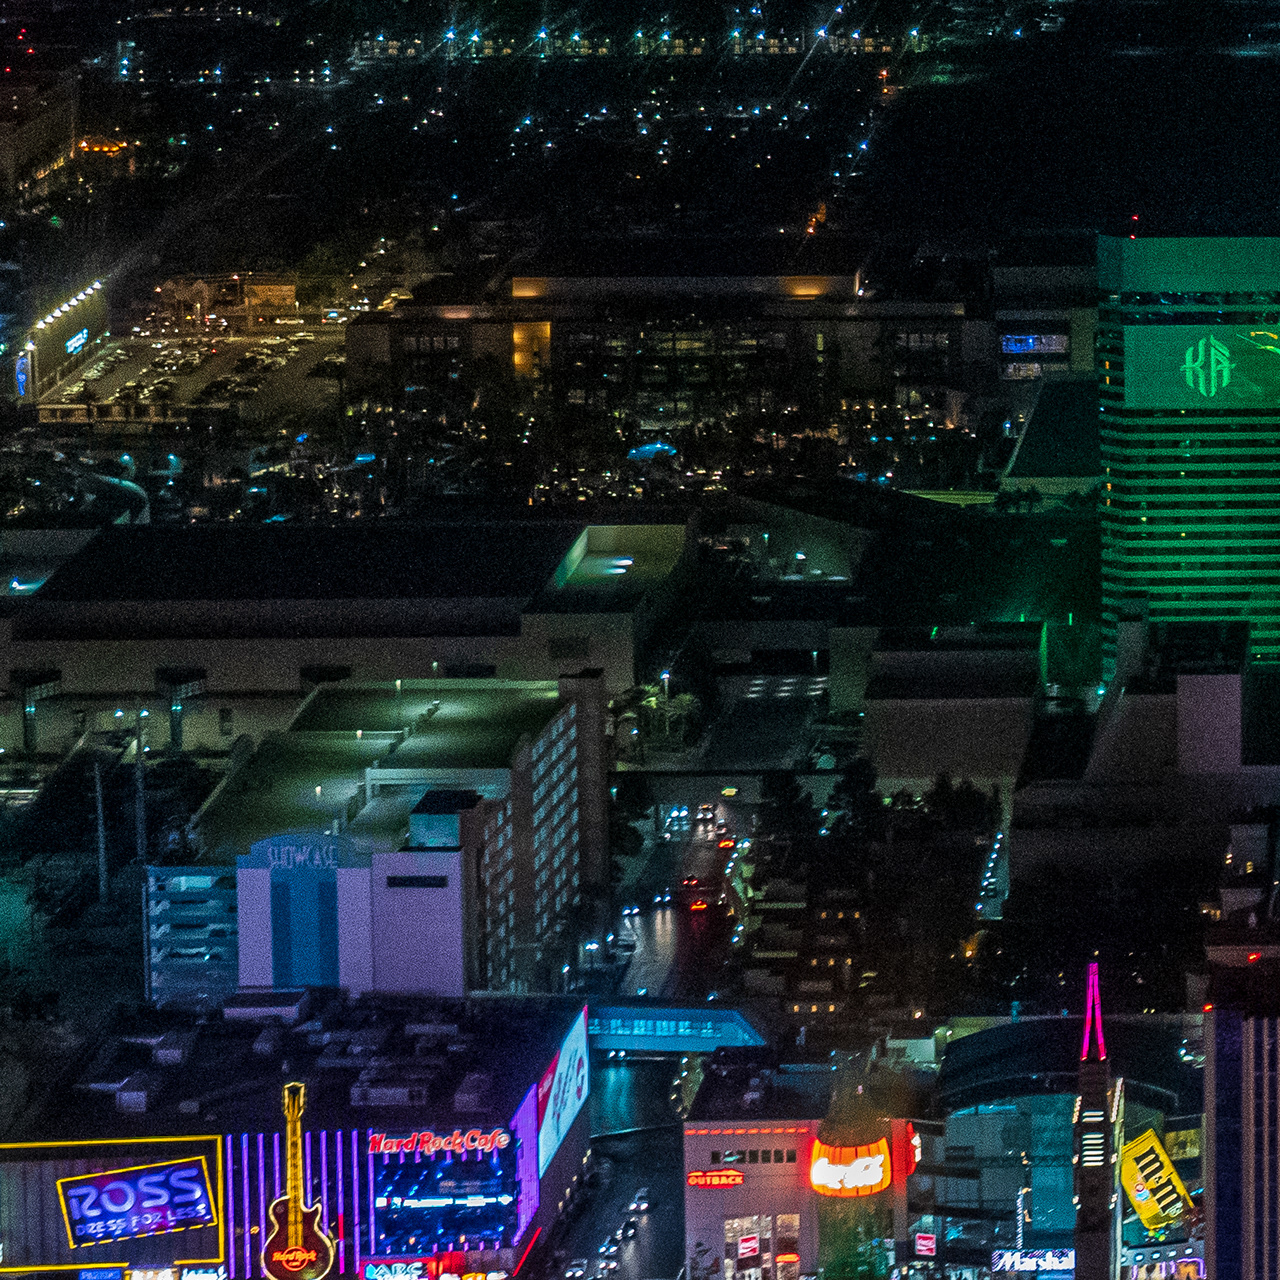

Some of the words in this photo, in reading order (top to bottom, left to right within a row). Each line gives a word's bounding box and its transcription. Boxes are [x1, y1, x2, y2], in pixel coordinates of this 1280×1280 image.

[367, 1132, 418, 1155] Hard
[418, 1130, 463, 1156] Rock
[464, 1127, 511, 1150] Cafe
[687, 1174, 745, 1187] OUTBACK
[67, 1167, 203, 1222] ROSS
[131, 1212, 163, 1229] FOR
[167, 1202, 207, 1221] LESS
[373, 1261, 424, 1277] ABC
